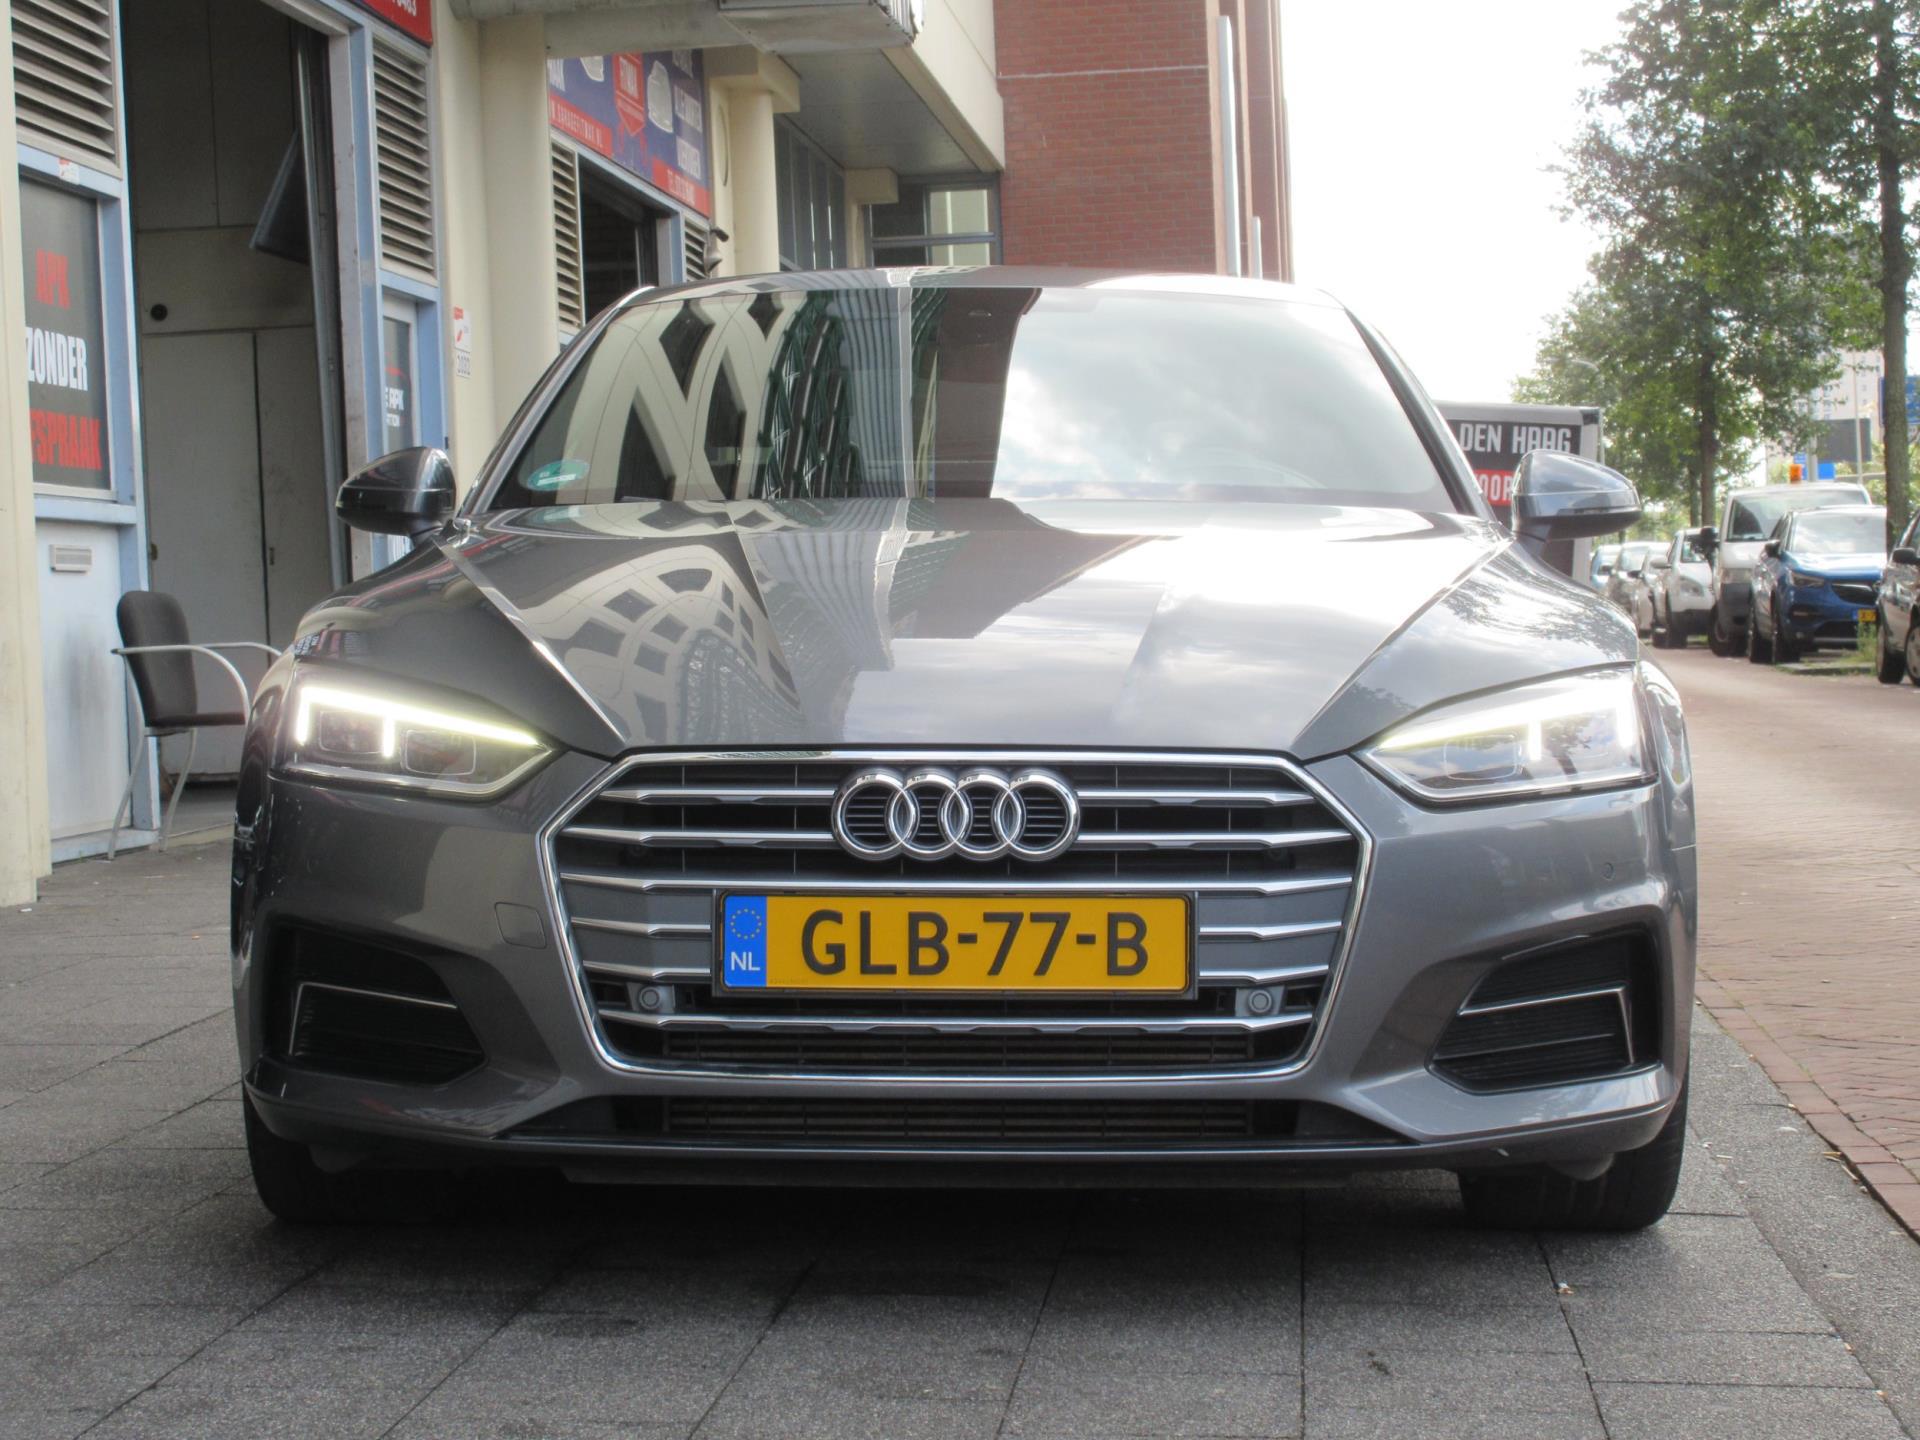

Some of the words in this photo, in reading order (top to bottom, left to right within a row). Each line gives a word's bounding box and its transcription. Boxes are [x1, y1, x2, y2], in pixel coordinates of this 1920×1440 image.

[25, 326, 88, 391] ZONDER
[1459, 423, 1502, 452] DEN
[1512, 425, 1572, 454] HAAG
[1474, 474, 1515, 500] OOR
[801, 909, 1148, 977] GLB-77-B
[730, 951, 761, 971] NL
